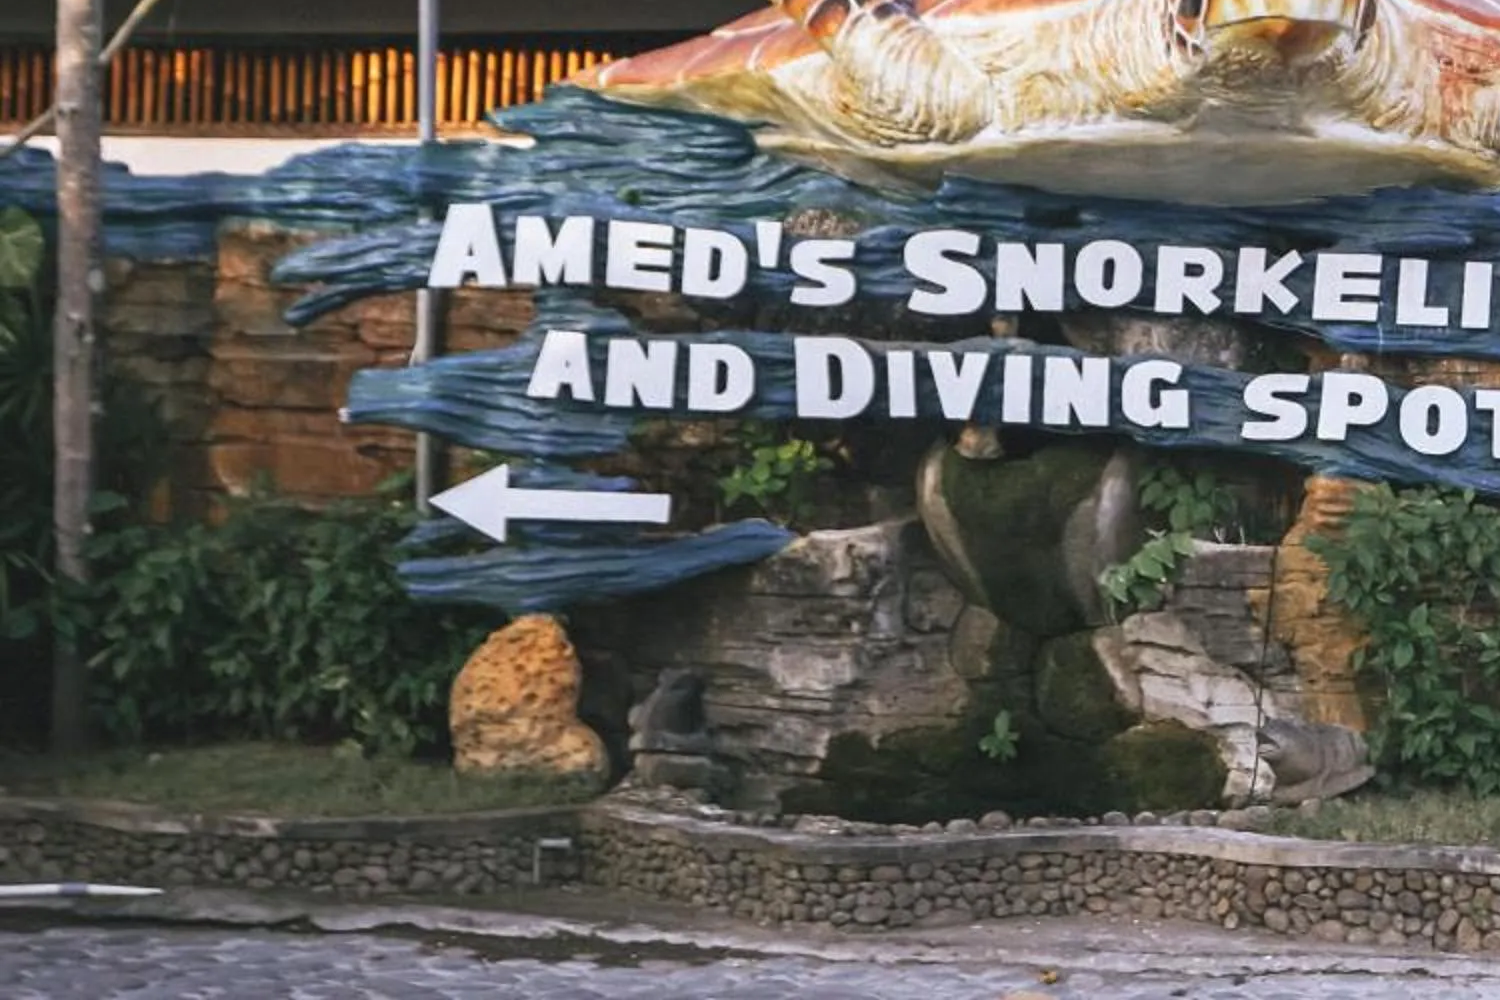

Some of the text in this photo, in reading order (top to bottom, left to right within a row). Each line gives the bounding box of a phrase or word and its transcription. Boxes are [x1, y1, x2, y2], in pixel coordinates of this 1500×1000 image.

[428, 202, 856, 305] AMED'S
[526, 329, 754, 412] AND
[794, 337, 1190, 428] DIVING
